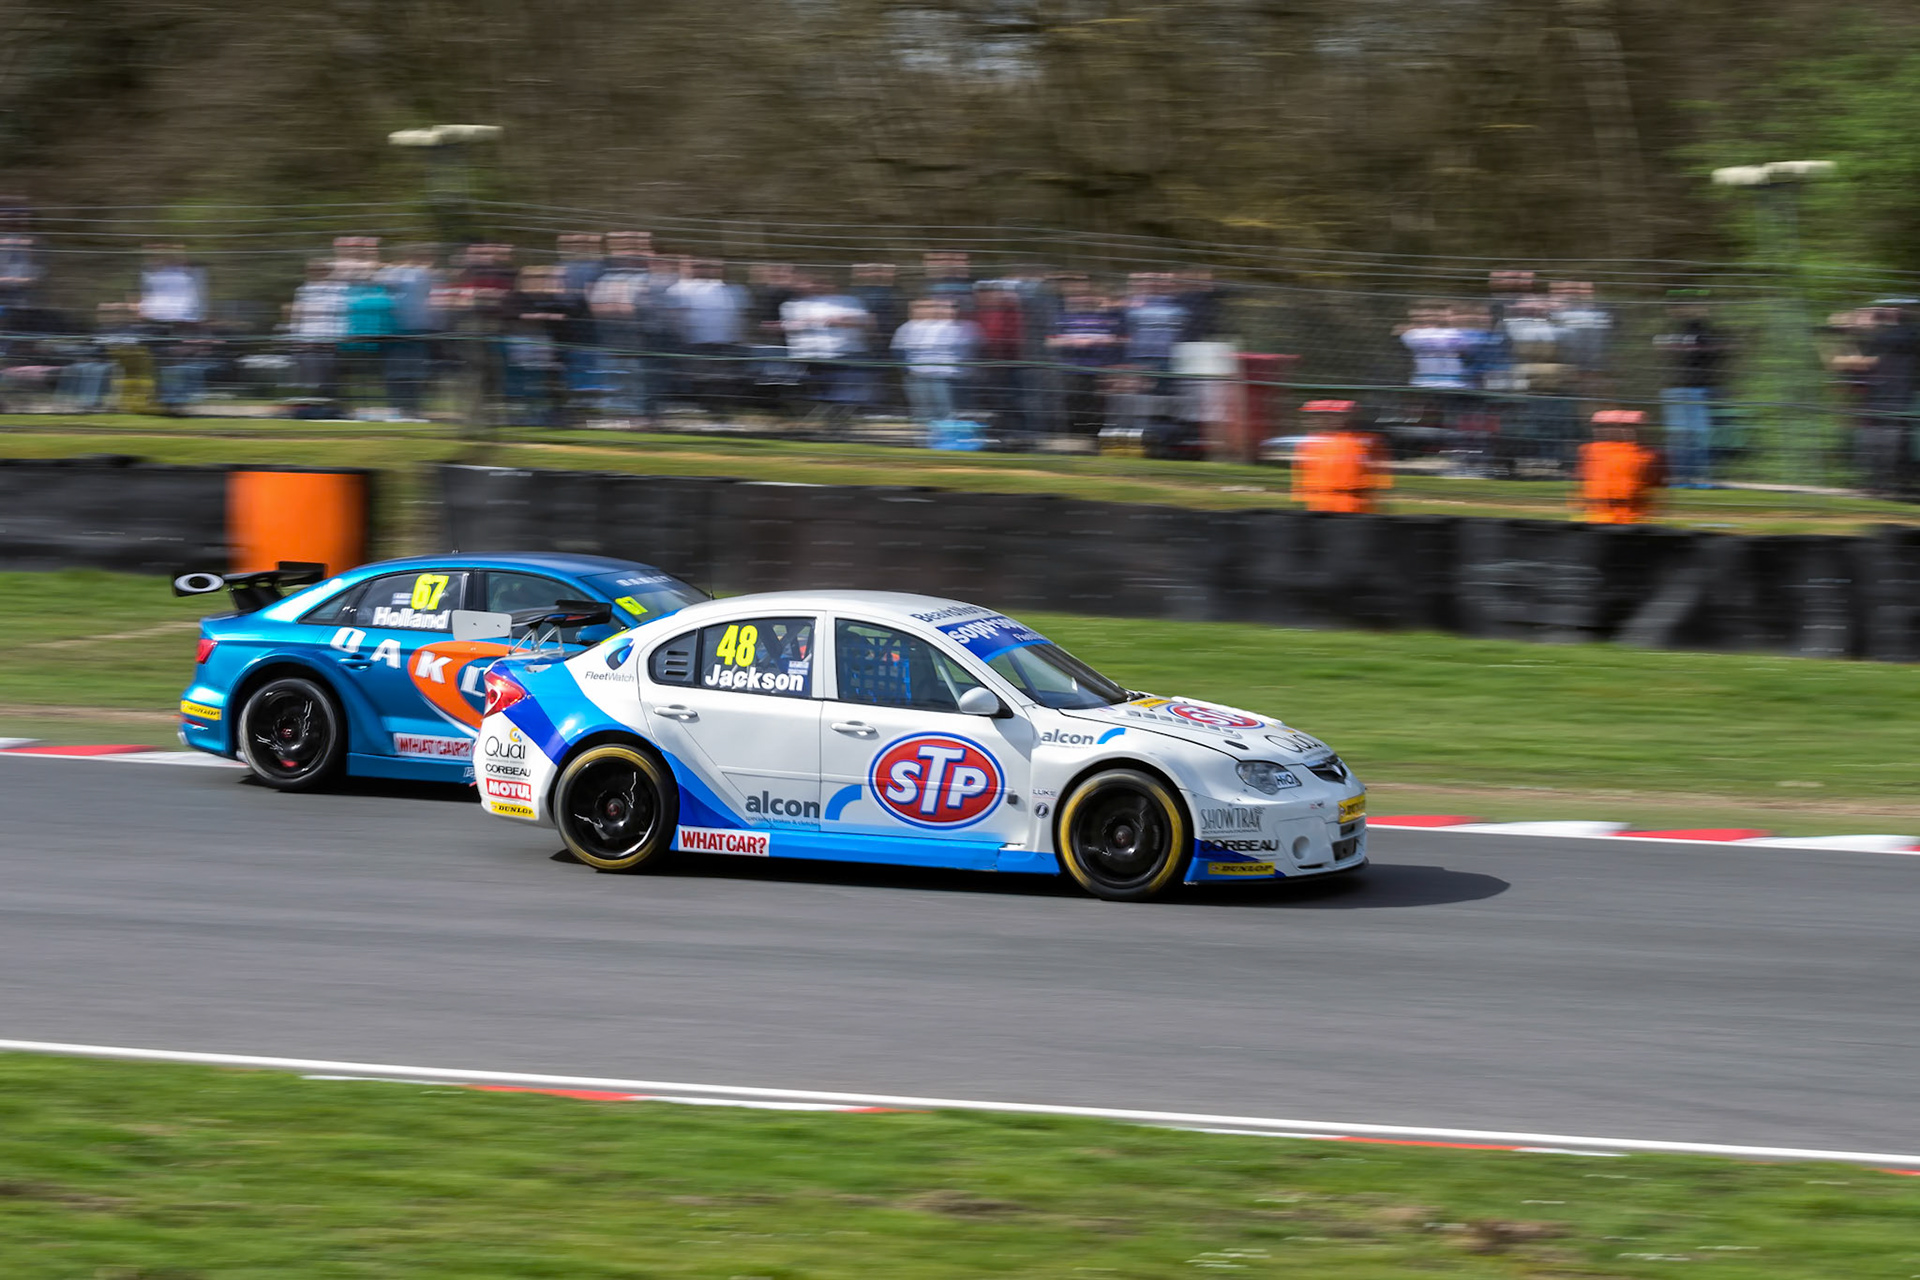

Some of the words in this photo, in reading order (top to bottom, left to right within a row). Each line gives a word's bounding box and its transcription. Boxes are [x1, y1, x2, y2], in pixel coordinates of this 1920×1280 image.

[411, 573, 449, 610] 67
[372, 606, 451, 629] Holland
[716, 624, 758, 667] 48
[705, 664, 804, 691] Jackson
[396, 737, 434, 753] WHAT
[1041, 729, 1094, 745] alcon
[485, 763, 531, 778] CORBEAU
[885, 745, 989, 815] STP
[488, 780, 531, 799] MOTUL
[498, 804, 534, 815] DUNLOP
[745, 790, 820, 818] alcon
[681, 830, 725, 850] WHAT
[726, 834, 766, 854] CAR?
[1201, 839, 1279, 852] CORBEAU
